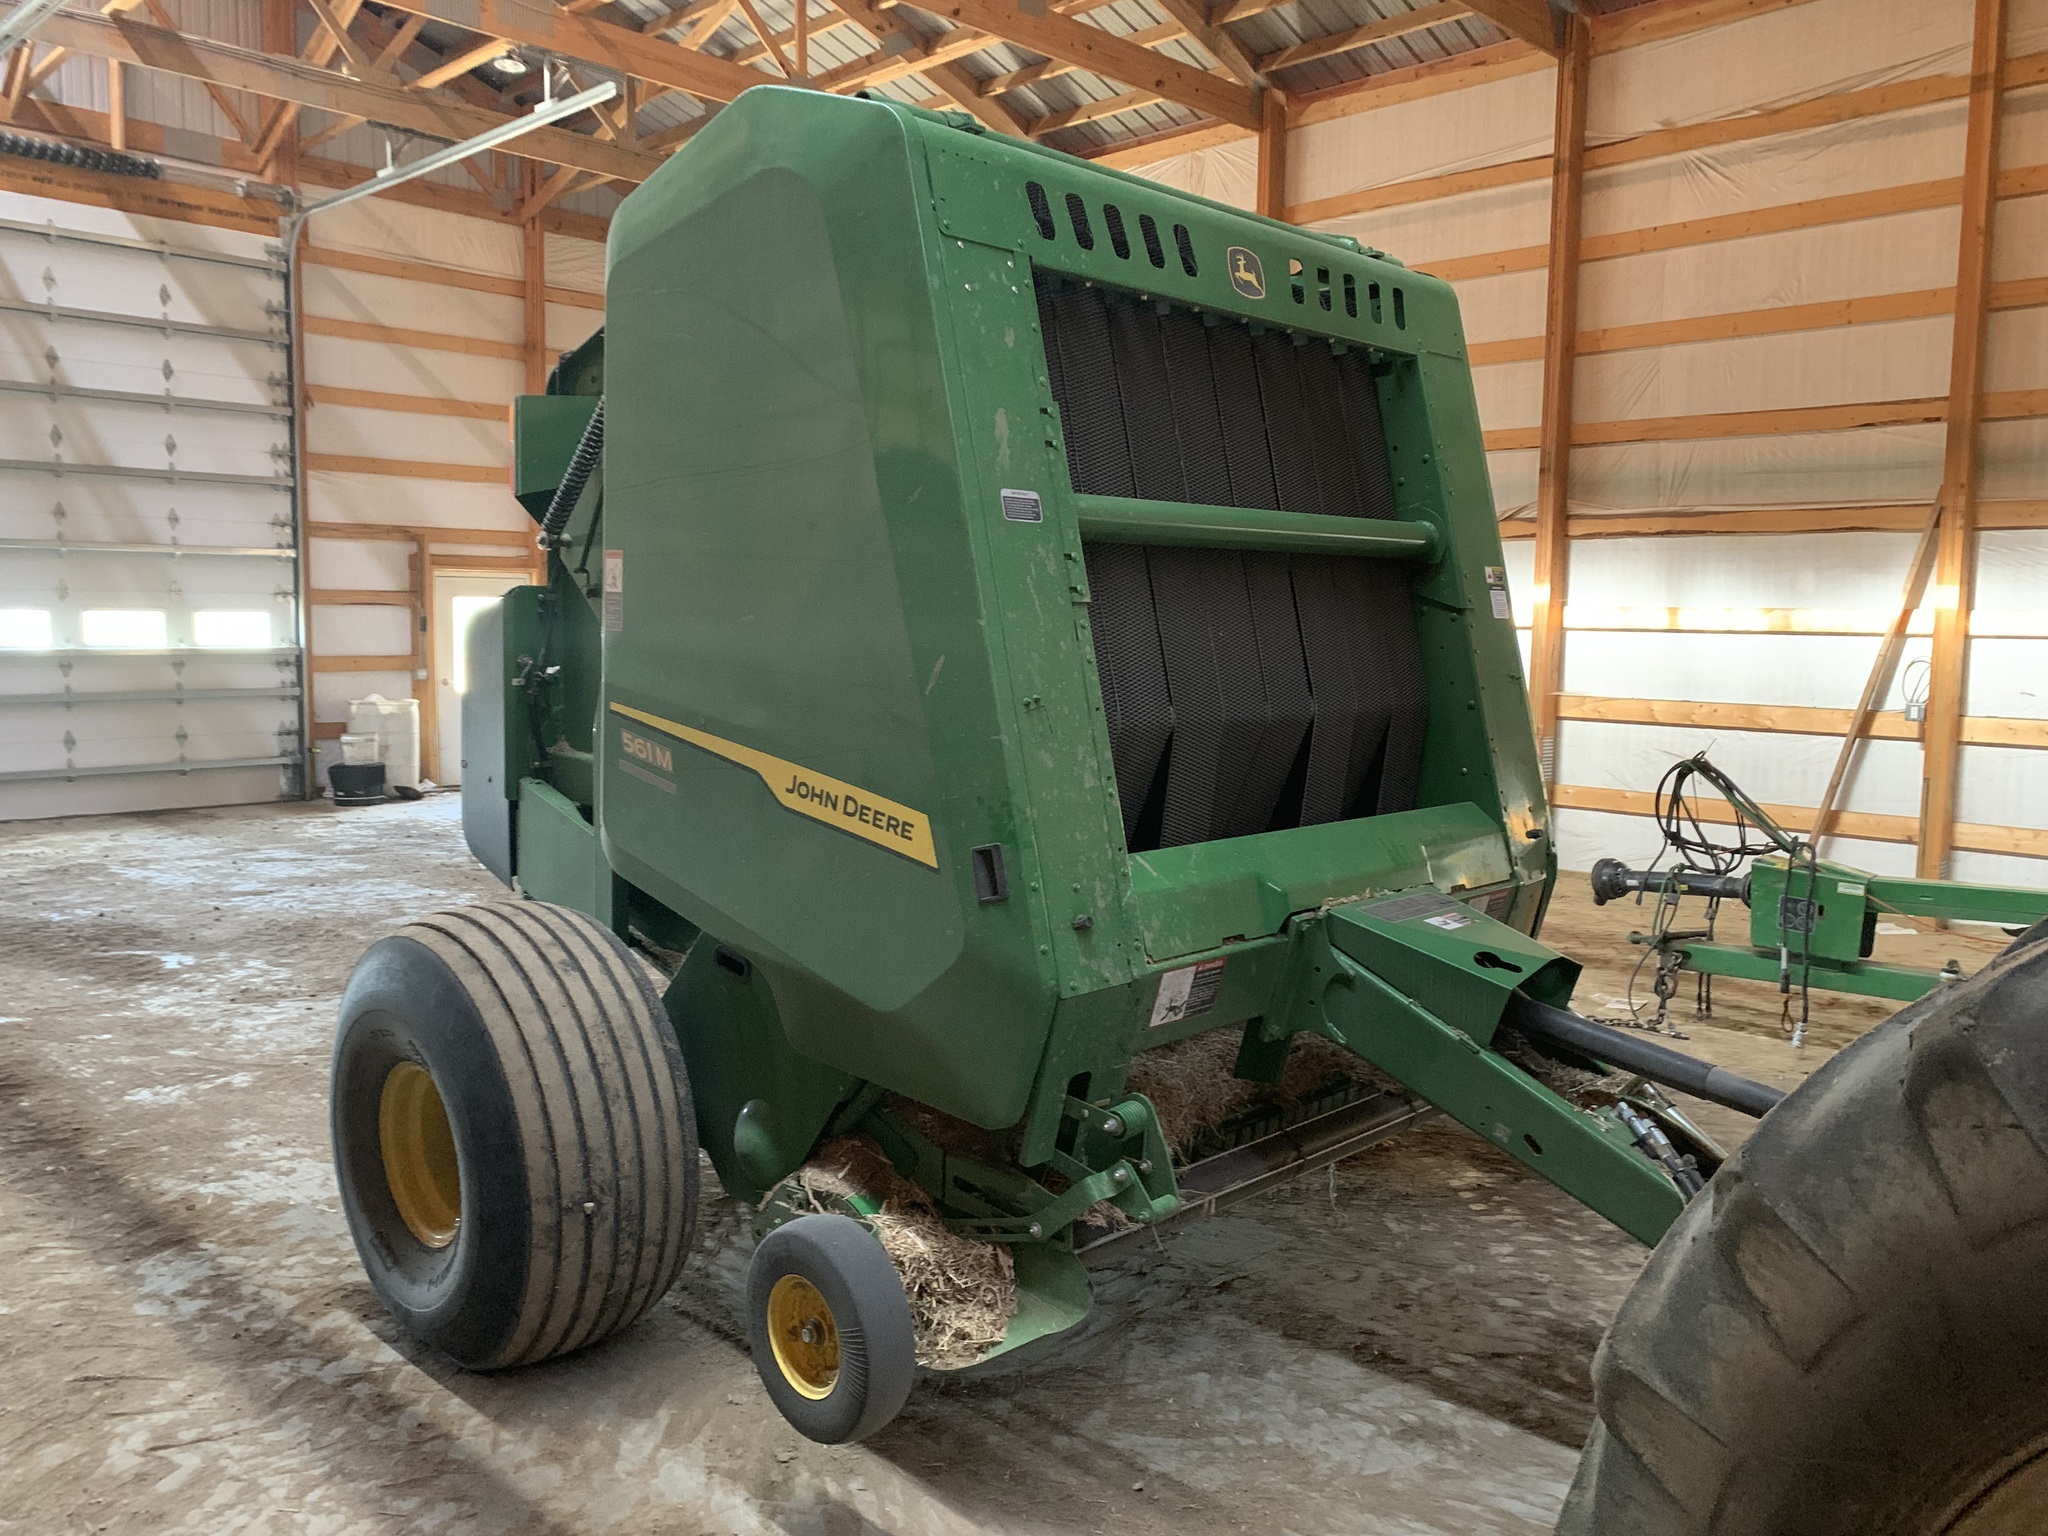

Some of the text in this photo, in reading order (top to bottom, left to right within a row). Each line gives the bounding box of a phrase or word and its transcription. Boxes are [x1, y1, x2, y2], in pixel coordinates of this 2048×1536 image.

[621, 731, 673, 772] 561M
[785, 775, 915, 841] JOHN DEERE
